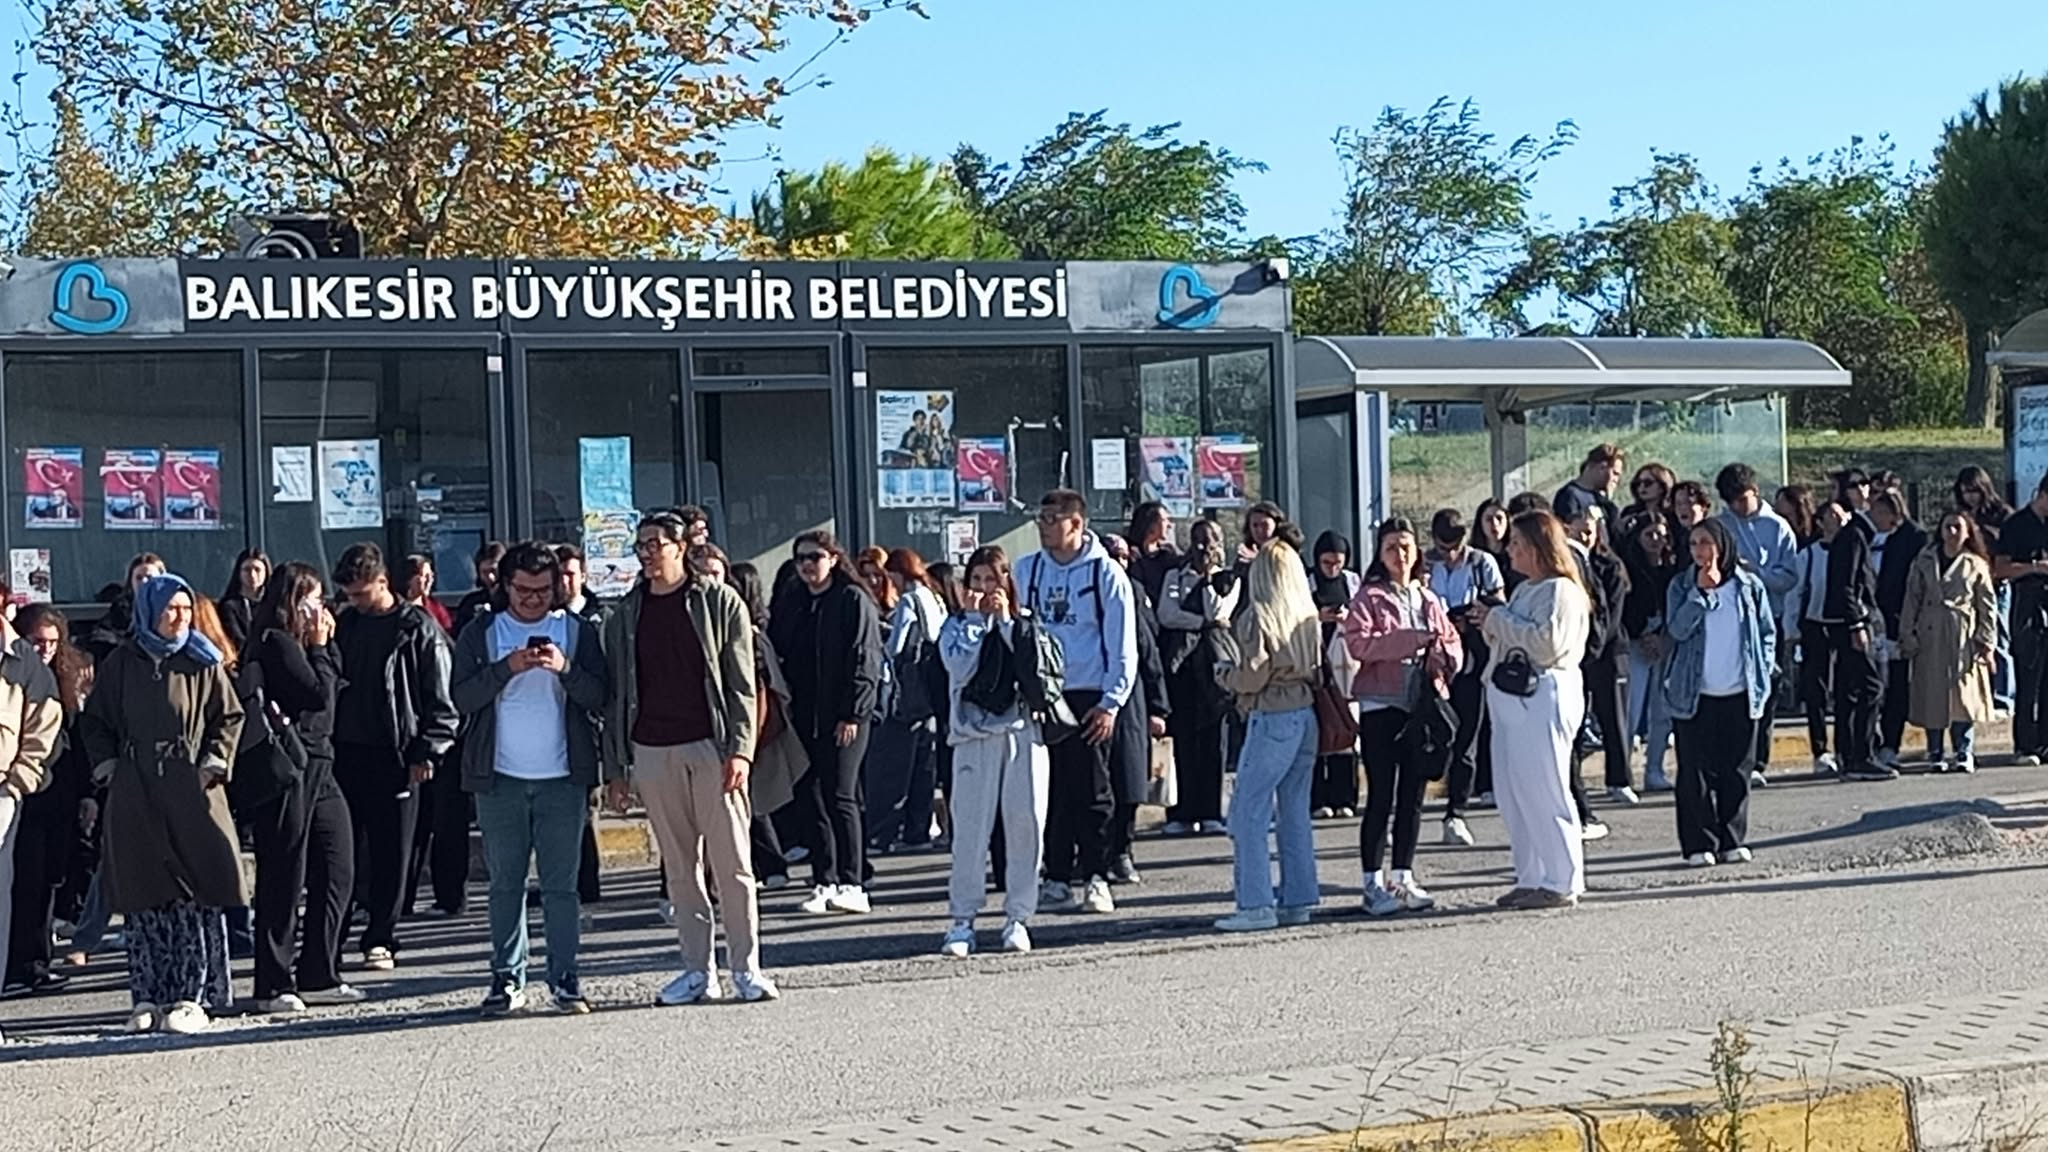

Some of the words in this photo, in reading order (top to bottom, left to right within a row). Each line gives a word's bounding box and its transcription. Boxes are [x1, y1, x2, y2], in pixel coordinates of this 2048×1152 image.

[186, 268, 456, 320] BALIKESİR
[472, 266, 795, 330] BÜYÜKŞEHİR
[810, 268, 1067, 319] BELEDİYESİ
